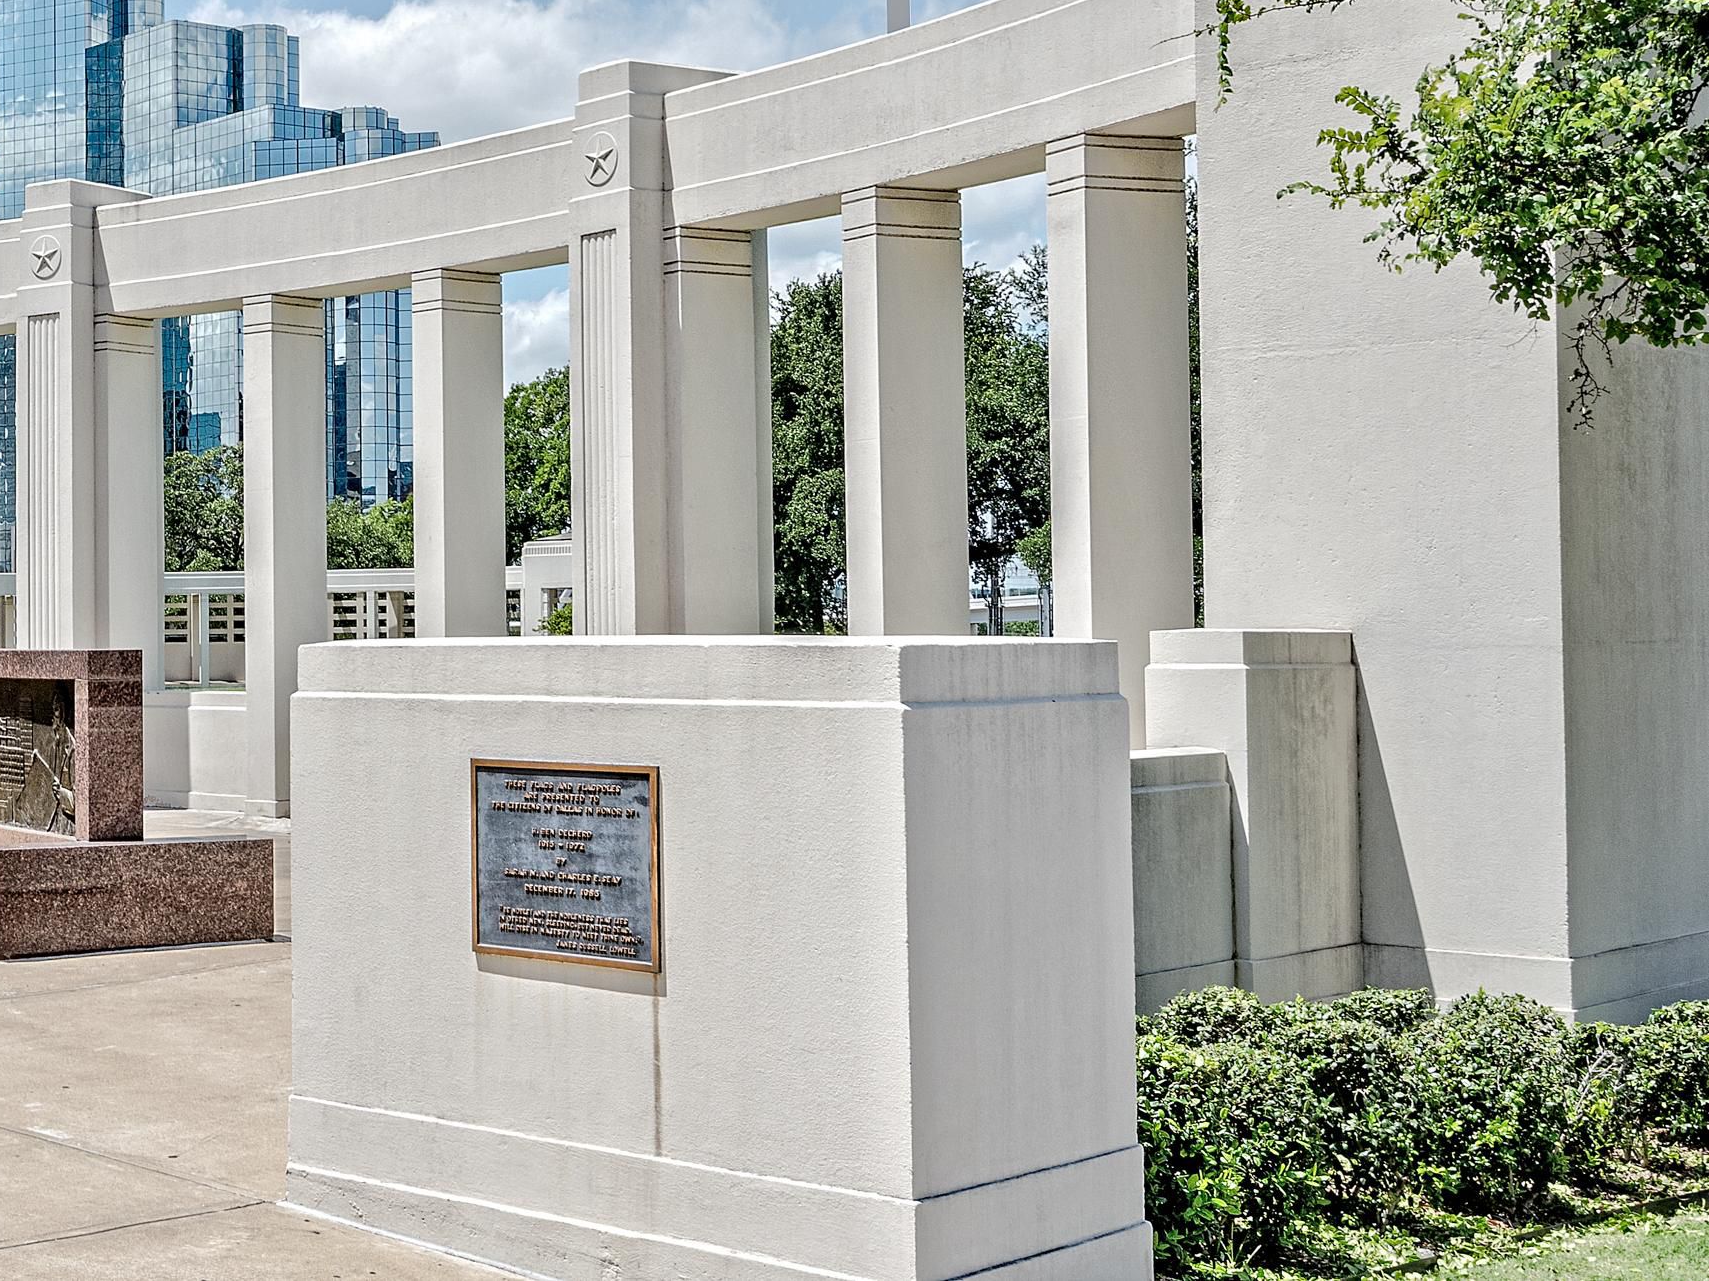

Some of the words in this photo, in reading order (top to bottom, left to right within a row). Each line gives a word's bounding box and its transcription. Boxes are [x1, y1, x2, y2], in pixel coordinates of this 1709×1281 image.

[504, 779, 526, 788] THESE
[530, 780, 553, 789] FLAGS
[557, 782, 572, 790] AND
[577, 783, 621, 793] FLAGPOLES
[523, 791, 537, 799] ARE
[542, 792, 585, 802] PRESENTED
[588, 794, 599, 803] TO
[491, 800, 505, 809] THE
[507, 801, 540, 811] CITIZENS
[542, 803, 552, 812] OF
[555, 804, 582, 813] DALLAS
[584, 805, 592, 814] IN
[596, 806, 622, 816] HONOR
[539, 827, 555, 836] BEN
[555, 856, 566, 865] BY
[504, 867, 528, 877] SARAH
[539, 870, 554, 879] AND
[557, 871, 590, 882] CHARLES
[601, 874, 622, 884] SEAY
[524, 883, 563, 894] DECEMBER
[555, 939, 577, 949] JAMES
[609, 945, 636, 955] LOWELL
